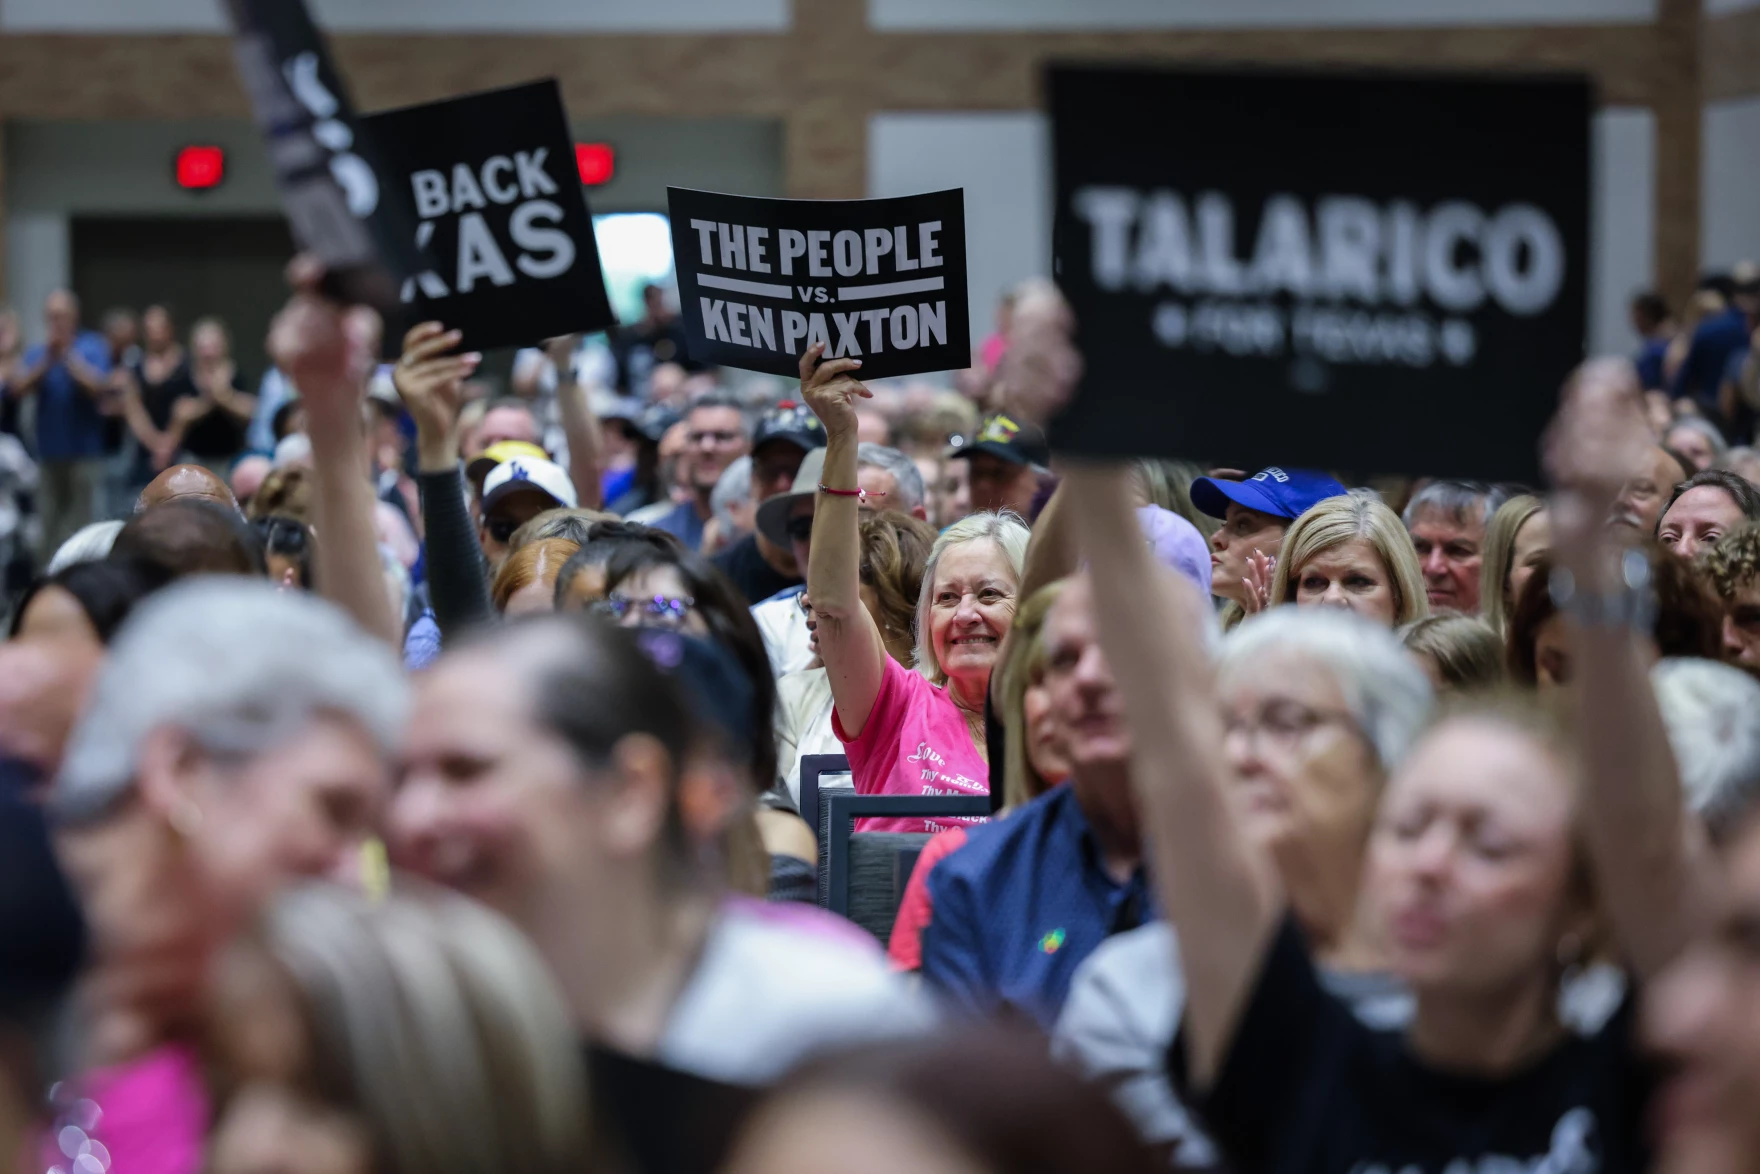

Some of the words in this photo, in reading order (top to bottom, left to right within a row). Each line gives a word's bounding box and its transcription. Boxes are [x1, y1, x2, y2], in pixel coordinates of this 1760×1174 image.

[410, 147, 559, 219] BACK
[690, 218, 772, 275] THE
[778, 220, 944, 278] PEOPLE
[1071, 185, 1566, 316] TALARICO
[699, 297, 778, 352] KEN
[781, 300, 948, 359] PAXTON
[906, 741, 946, 767] Love
[920, 768, 940, 783] Thy
